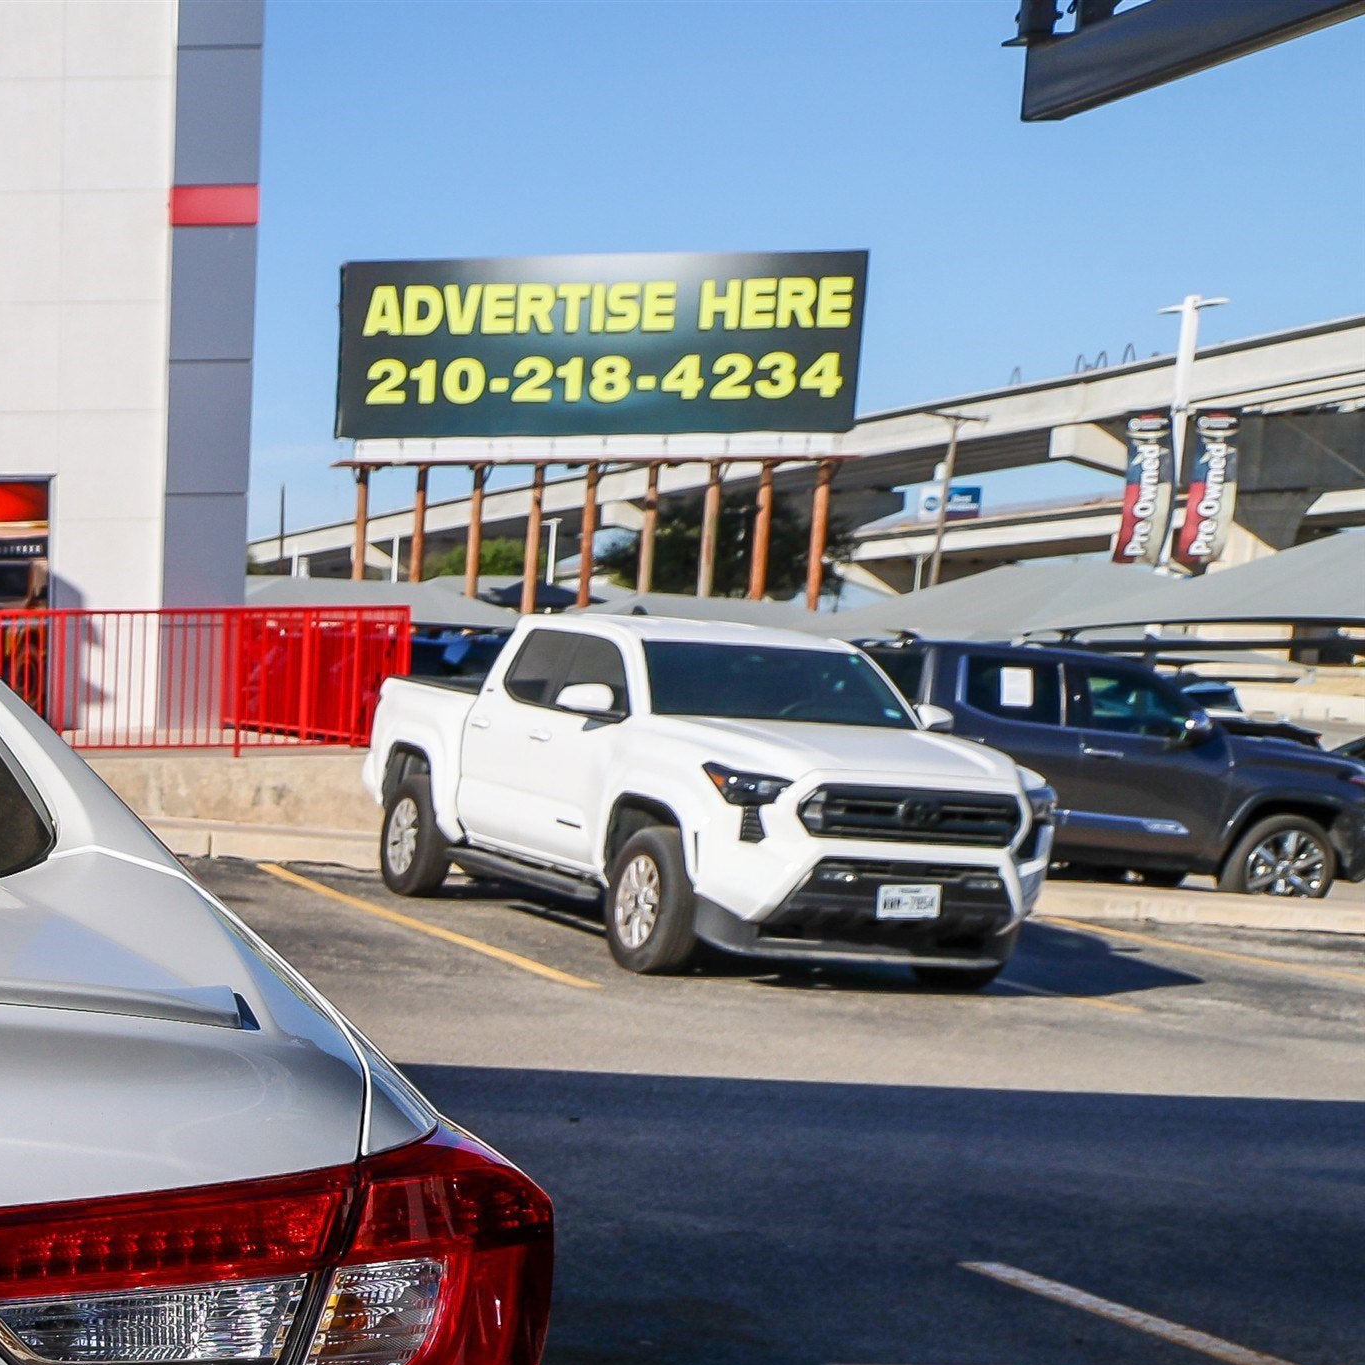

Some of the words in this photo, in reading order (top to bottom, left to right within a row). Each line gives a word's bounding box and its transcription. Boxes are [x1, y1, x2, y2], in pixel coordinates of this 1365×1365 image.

[362, 280, 678, 337] ADVERTISE
[697, 276, 855, 332] HERE
[364, 351, 844, 405] 210-218-4234
